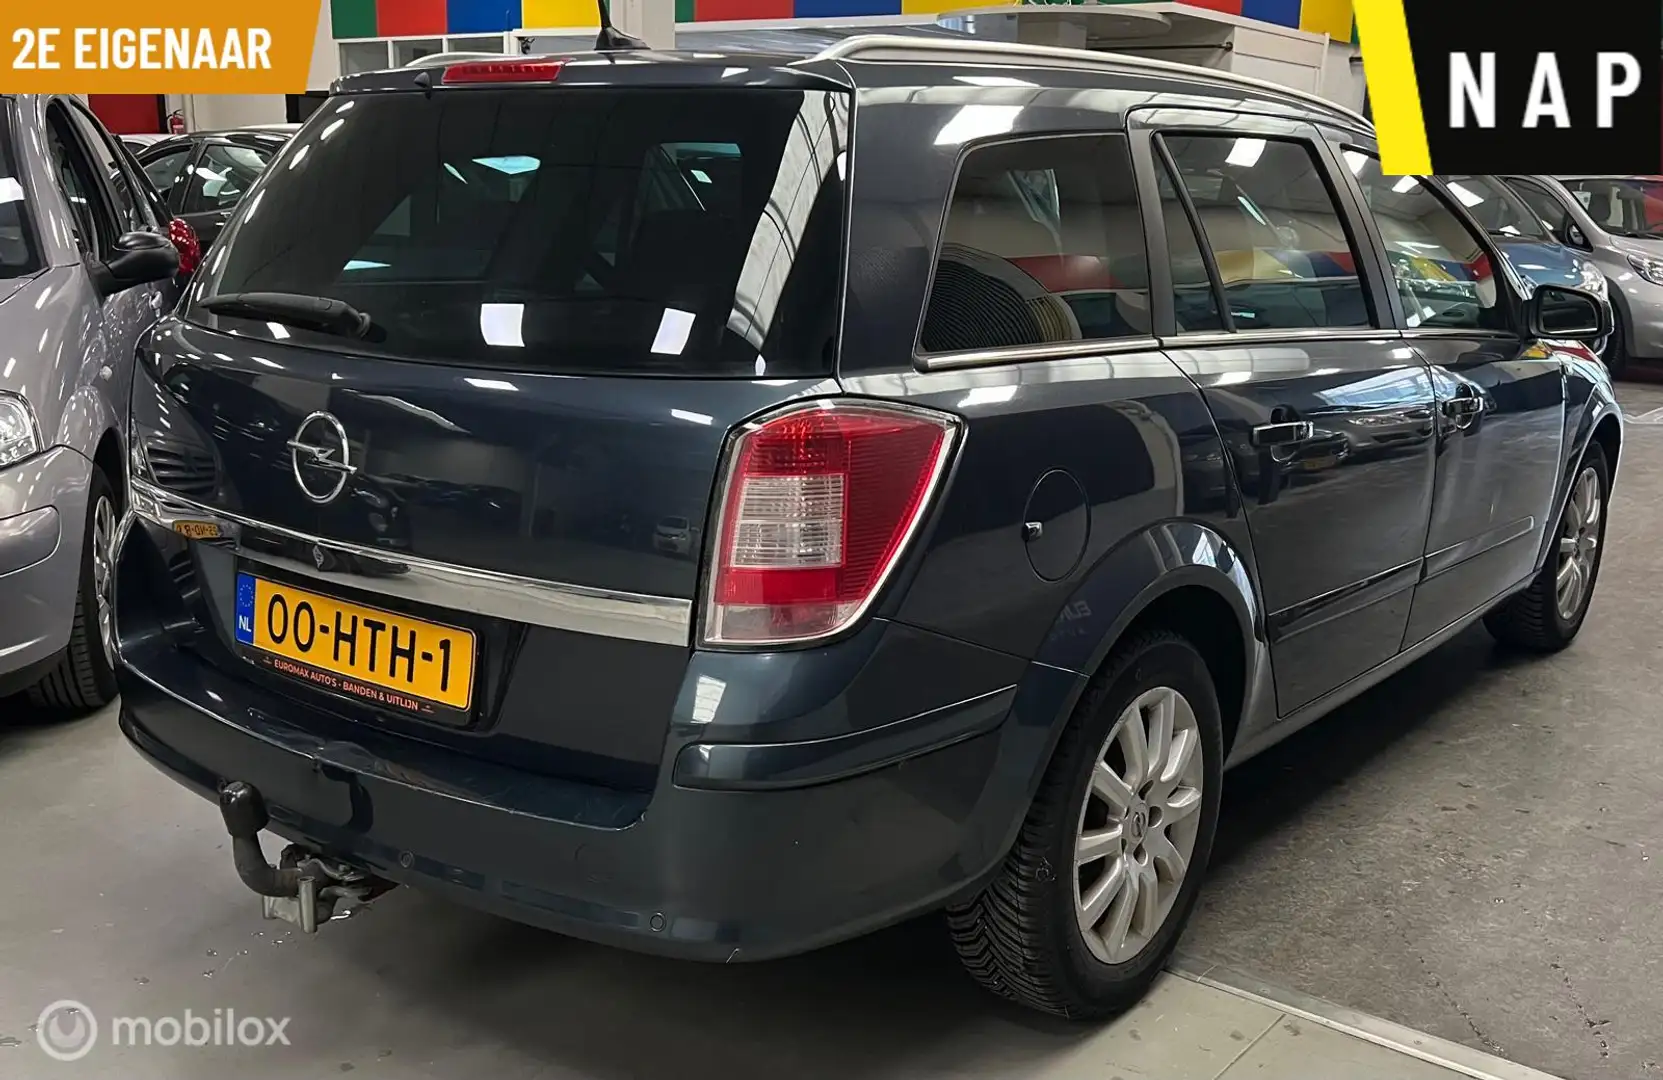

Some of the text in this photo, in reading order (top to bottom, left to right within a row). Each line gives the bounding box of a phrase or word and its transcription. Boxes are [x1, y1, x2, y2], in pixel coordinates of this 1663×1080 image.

[238, 614, 252, 633] NL
[267, 593, 451, 692] 00-HTH-1
[274, 659, 309, 678] EUROMAX
[310, 672, 338, 688] AUTO'S
[343, 681, 378, 699] BANDEN
[379, 692, 385, 701] &
[386, 693, 419, 711] UITLIJN
